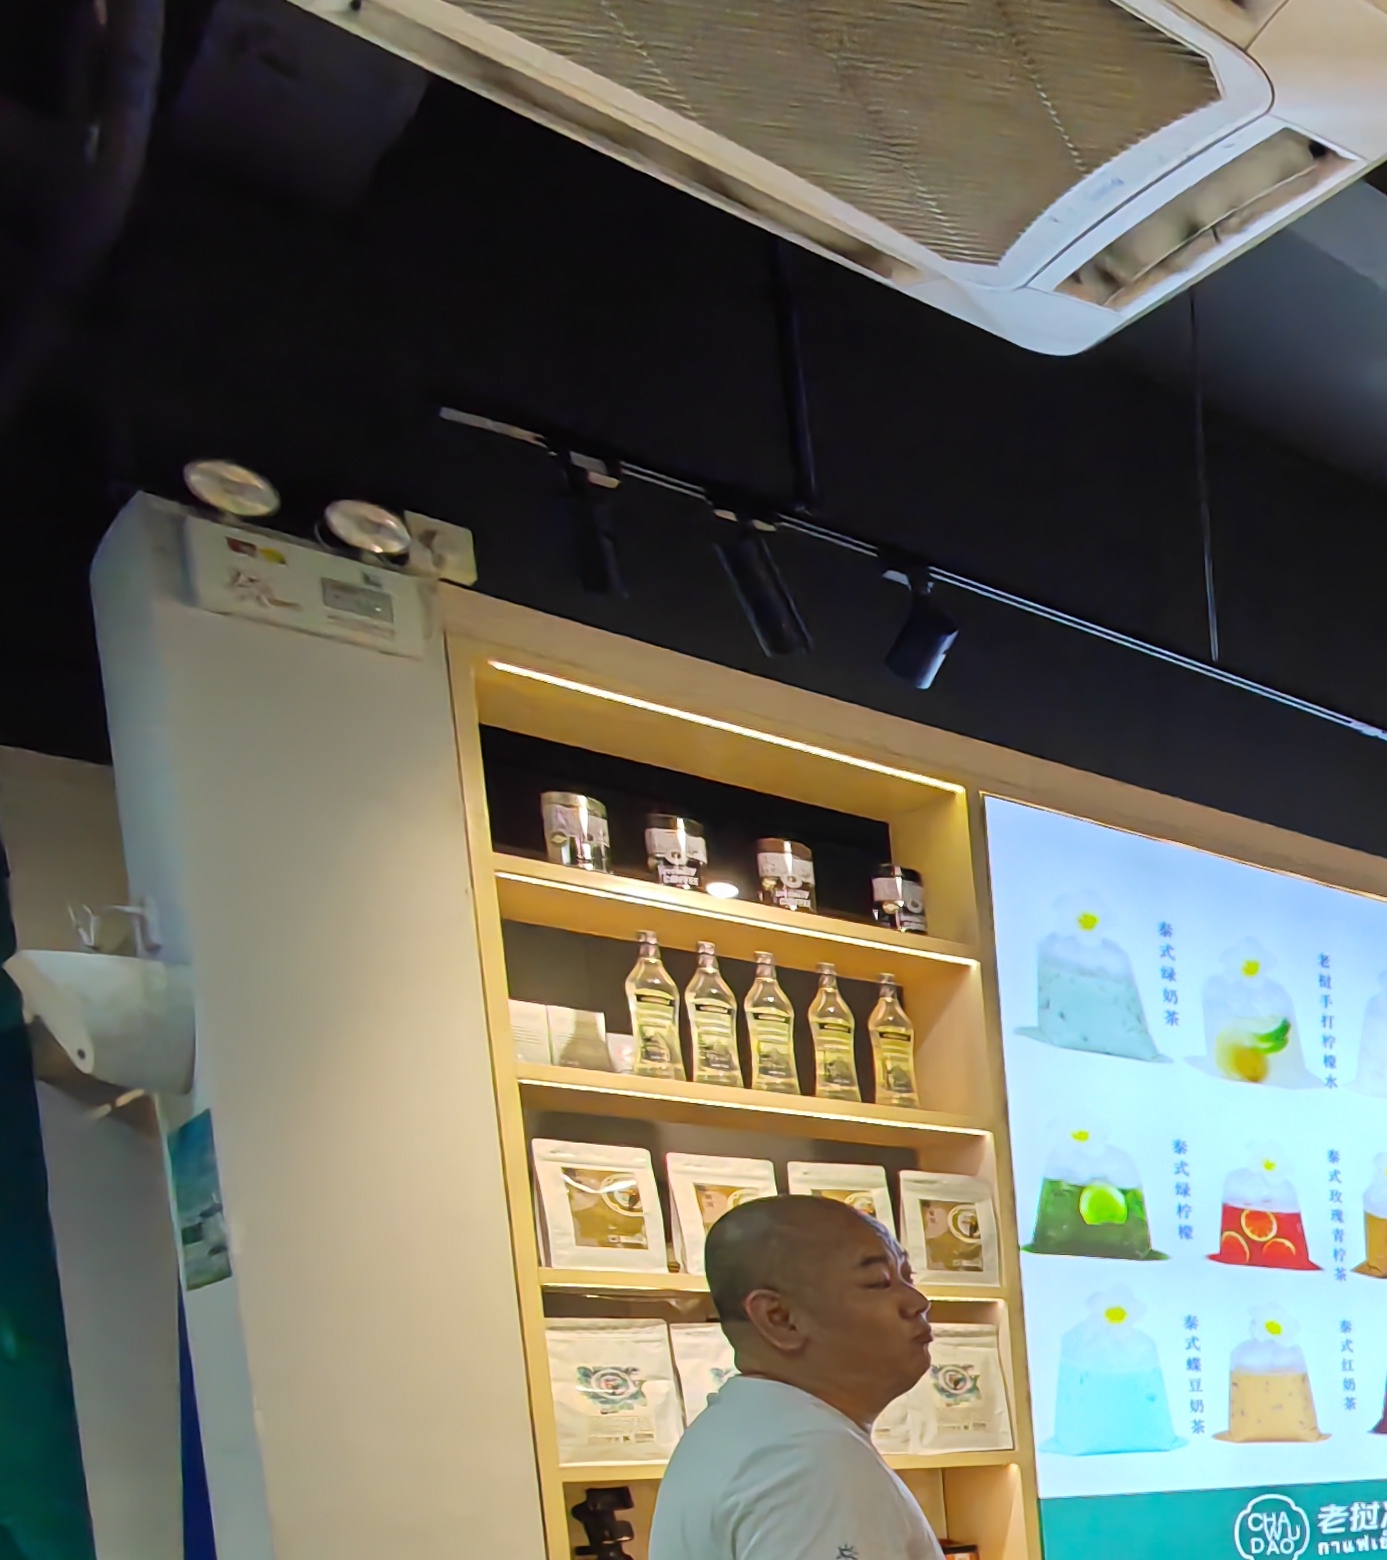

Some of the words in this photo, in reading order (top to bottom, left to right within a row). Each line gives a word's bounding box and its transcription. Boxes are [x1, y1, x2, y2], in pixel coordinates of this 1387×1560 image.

[1157, 920, 1180, 1027] 泰式绿奶茶
[1172, 1138, 1194, 1241] 泰式绿柠檬
[1340, 1319, 1357, 1411] 泰式红奶茶
[1247, 1511, 1292, 1533] CHA
[1250, 1536, 1295, 1556] DAO
